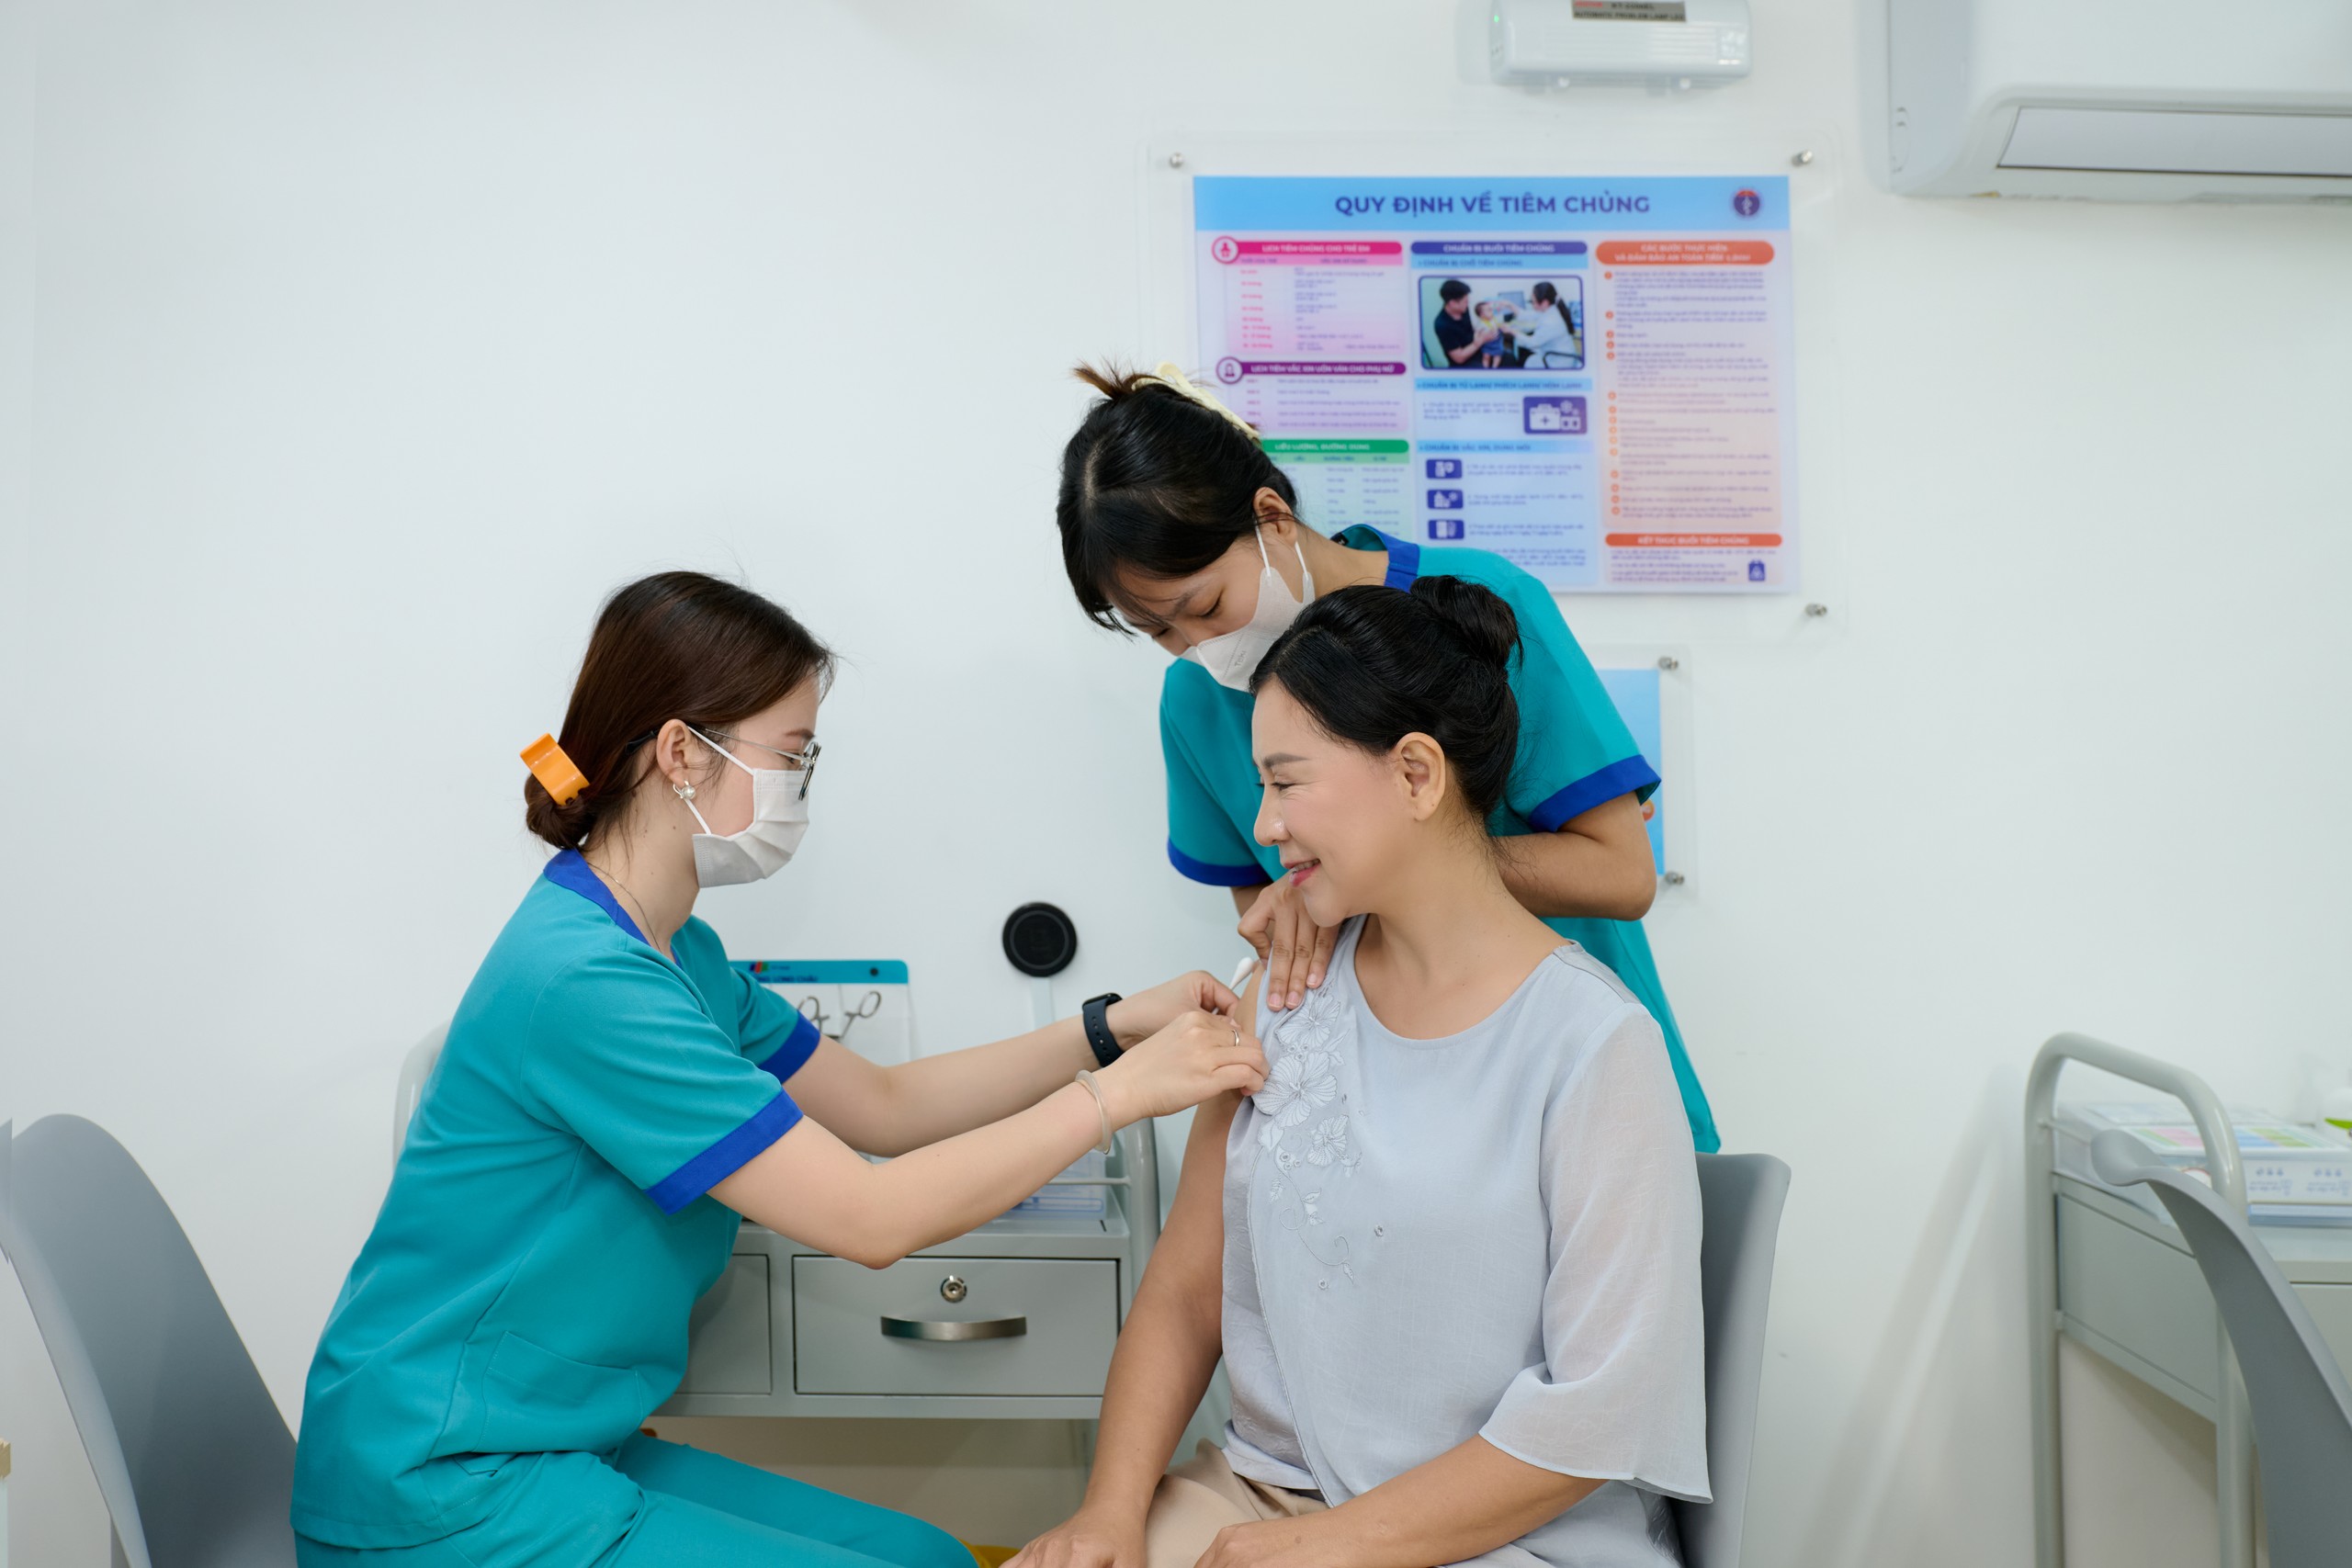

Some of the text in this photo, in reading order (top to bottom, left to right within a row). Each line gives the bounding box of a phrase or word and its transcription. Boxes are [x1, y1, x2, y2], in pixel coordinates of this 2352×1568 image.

[1335, 196, 1385, 217] QUY
[1393, 196, 1453, 218] ĐỊNH
[1498, 191, 1556, 213] TIÊM
